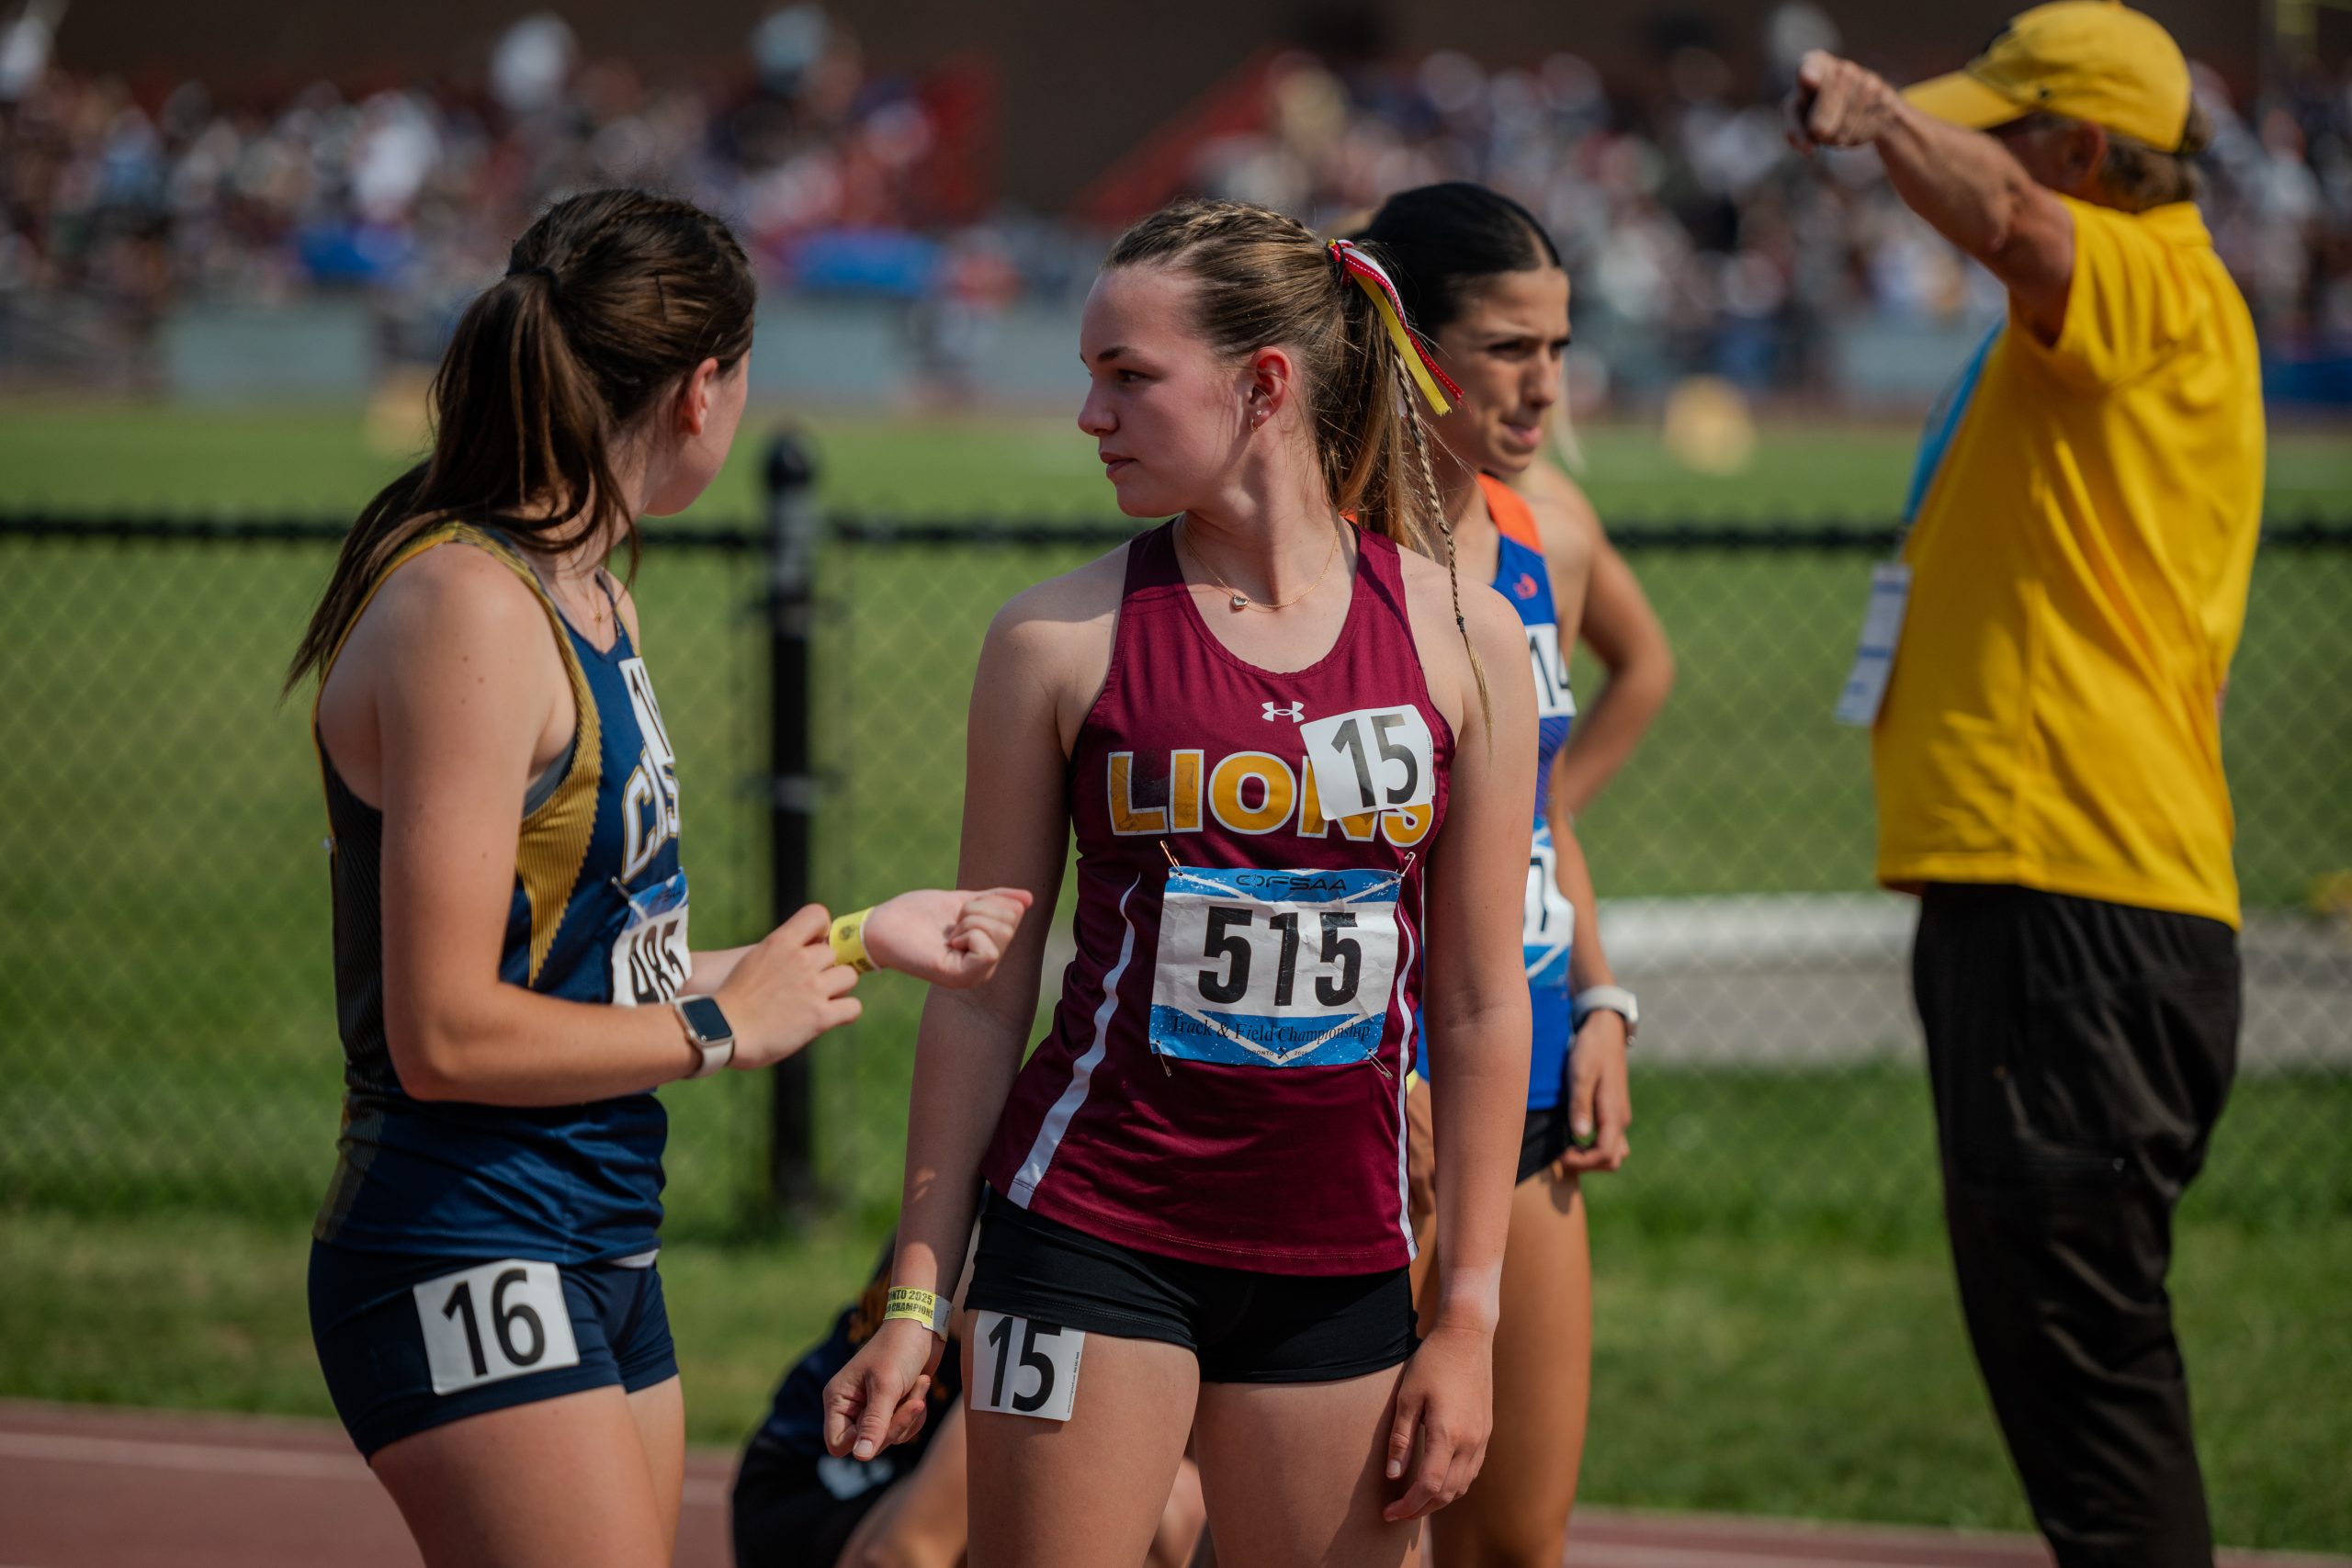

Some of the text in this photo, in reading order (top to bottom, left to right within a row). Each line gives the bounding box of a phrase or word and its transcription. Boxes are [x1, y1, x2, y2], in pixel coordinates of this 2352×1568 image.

[1330, 713, 1419, 808] 15
[1198, 906, 1362, 1007] 515
[1170, 1015, 1371, 1045] Track & Field Championship
[442, 1268, 545, 1378] 16
[908, 1290, 933, 1305] 2025
[988, 1315, 1063, 1413] 15
